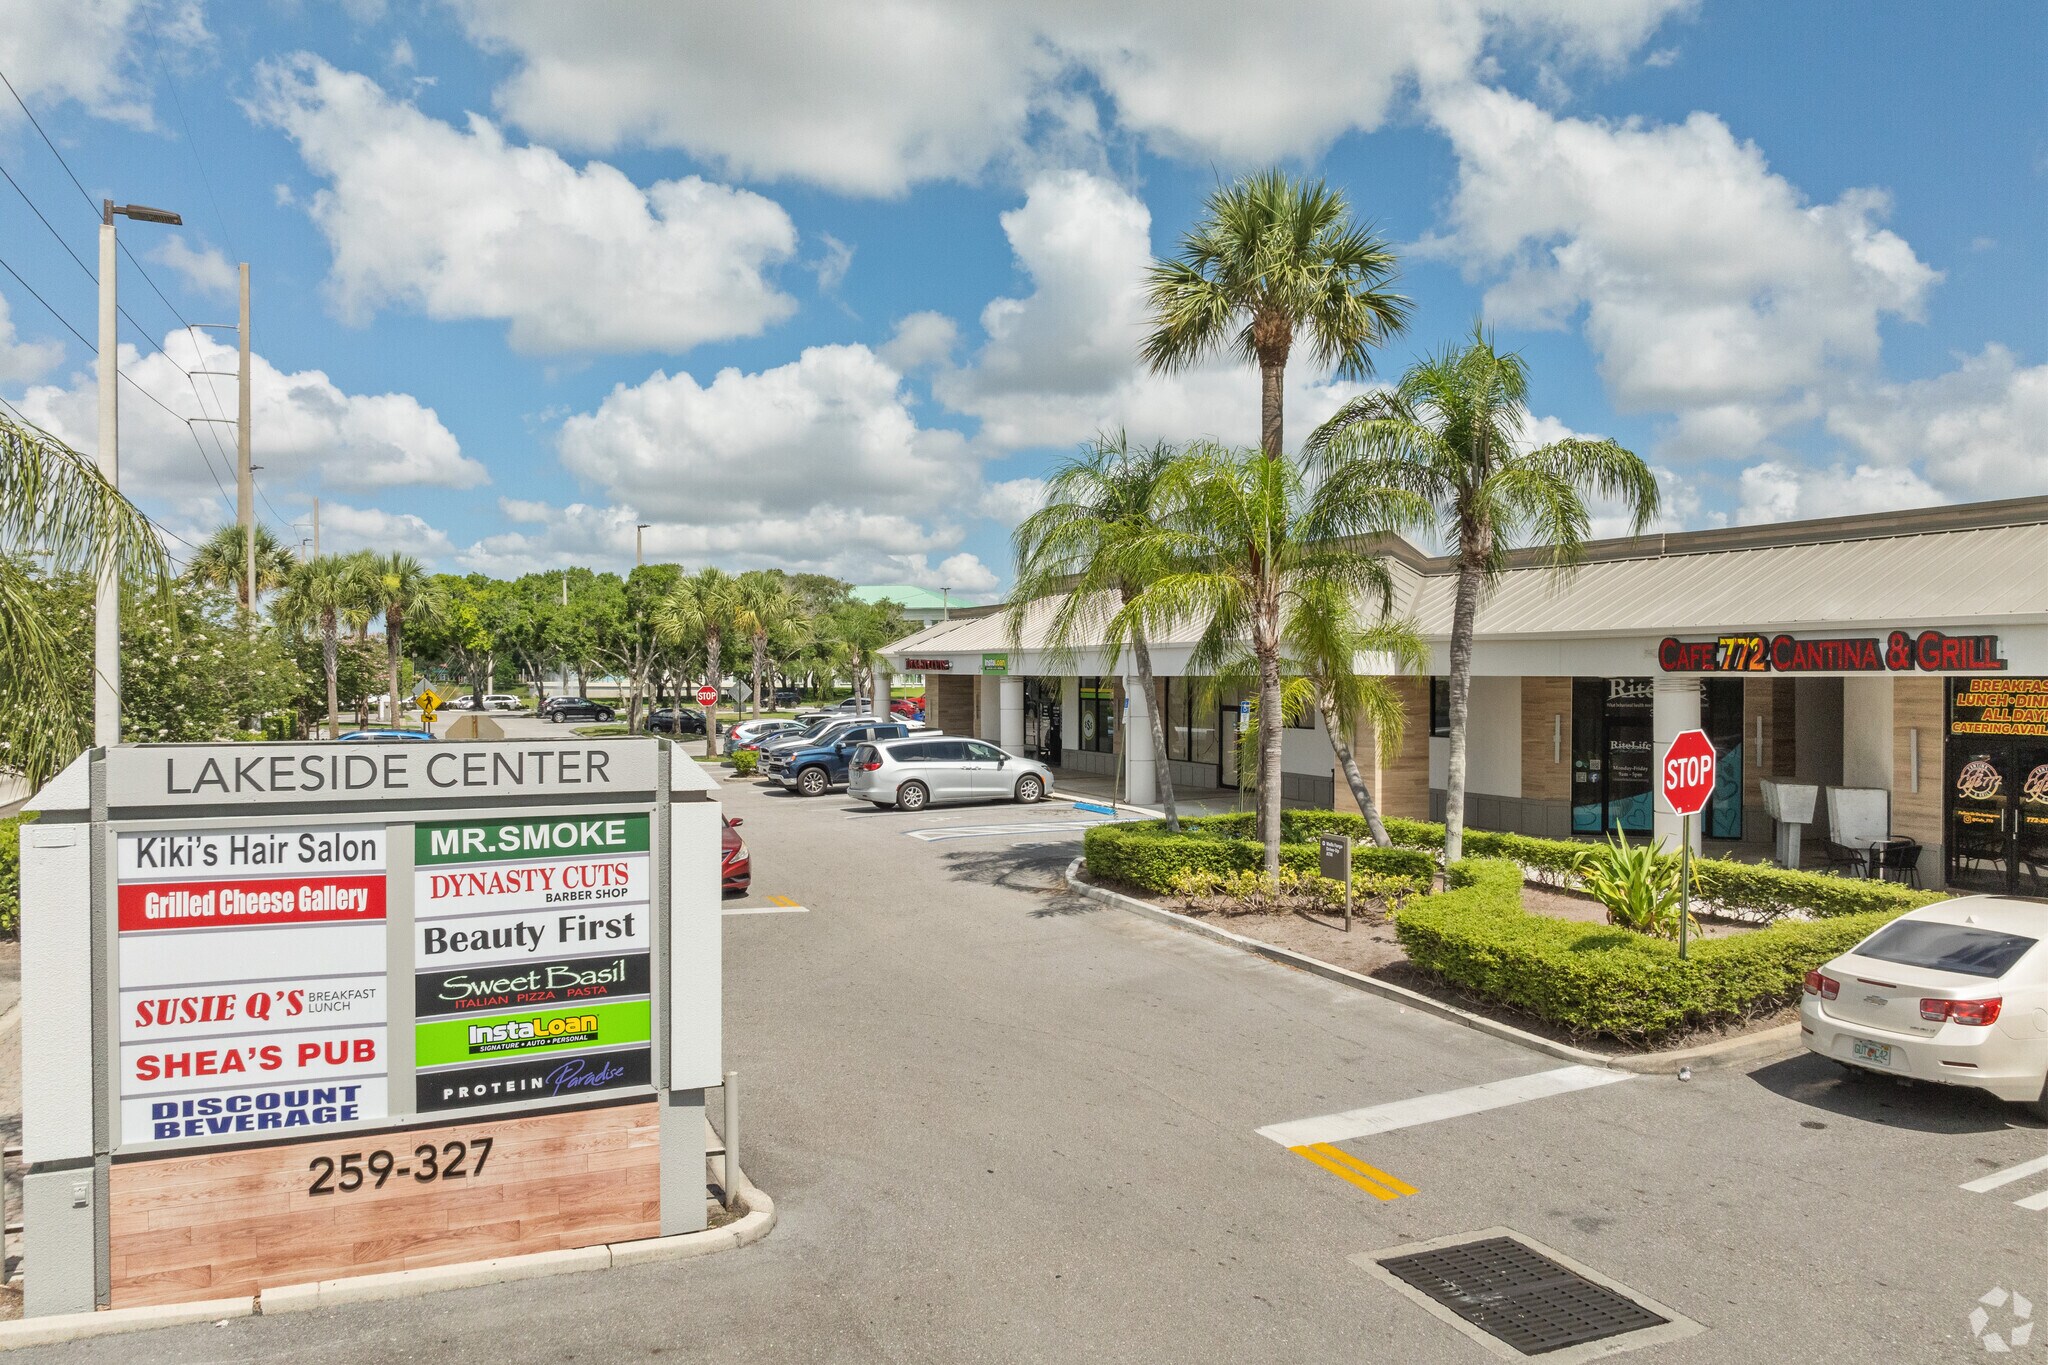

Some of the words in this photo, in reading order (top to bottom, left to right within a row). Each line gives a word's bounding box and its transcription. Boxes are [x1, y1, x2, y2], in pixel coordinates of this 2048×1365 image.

[1660, 637, 1714, 671] CAFE
[1717, 636, 1766, 671] 772
[1771, 635, 1879, 670] CANTINA
[1887, 631, 1912, 670] &
[1916, 631, 2003, 670] GRILL
[698, 692, 716, 700] STOP
[1957, 693, 2009, 706] LUNCH
[1952, 722, 2010, 734] CATERING
[1981, 708, 2011, 721] ALL
[166, 752, 410, 795] LAKESIDE
[426, 749, 611, 787] CENTER
[1666, 755, 1712, 790] STOP
[136, 838, 220, 869] Kiki's
[229, 834, 289, 867] Hair
[298, 831, 377, 864] Salon
[431, 819, 628, 855] MR.SMOKE
[430, 867, 556, 901] DYNASTY
[561, 863, 630, 890] CUTS
[545, 891, 593, 903] BARBER
[595, 888, 630, 900] SHOP
[145, 891, 216, 920] Grilled
[220, 888, 295, 916] Cheese
[299, 885, 369, 915] Gallery
[424, 920, 547, 956] Beauty
[558, 912, 636, 943] First
[308, 988, 377, 1003] BREAKFAST
[438, 970, 541, 1001] Sweet
[545, 959, 627, 990] Basil
[455, 995, 509, 1009] ITALIAN
[516, 990, 556, 1004] PIZZA
[566, 985, 608, 998] PASTA
[135, 994, 236, 1029] SUSIE
[245, 988, 305, 1020] Q'S
[308, 999, 352, 1014] LUNCH
[468, 1014, 600, 1045] InstaLoan
[479, 1041, 521, 1053] SIGNATURE
[525, 1038, 546, 1048] AUTO
[551, 1034, 589, 1045] PERSONAL
[136, 1045, 284, 1082] SHEA'S
[298, 1038, 377, 1067] PUB
[443, 1077, 544, 1100] PROTEIN
[545, 1058, 625, 1097] Paradise
[152, 1085, 362, 1121] DISCOUNT
[153, 1105, 360, 1140] BEVERAGE
[308, 1137, 495, 1198] 259-327
